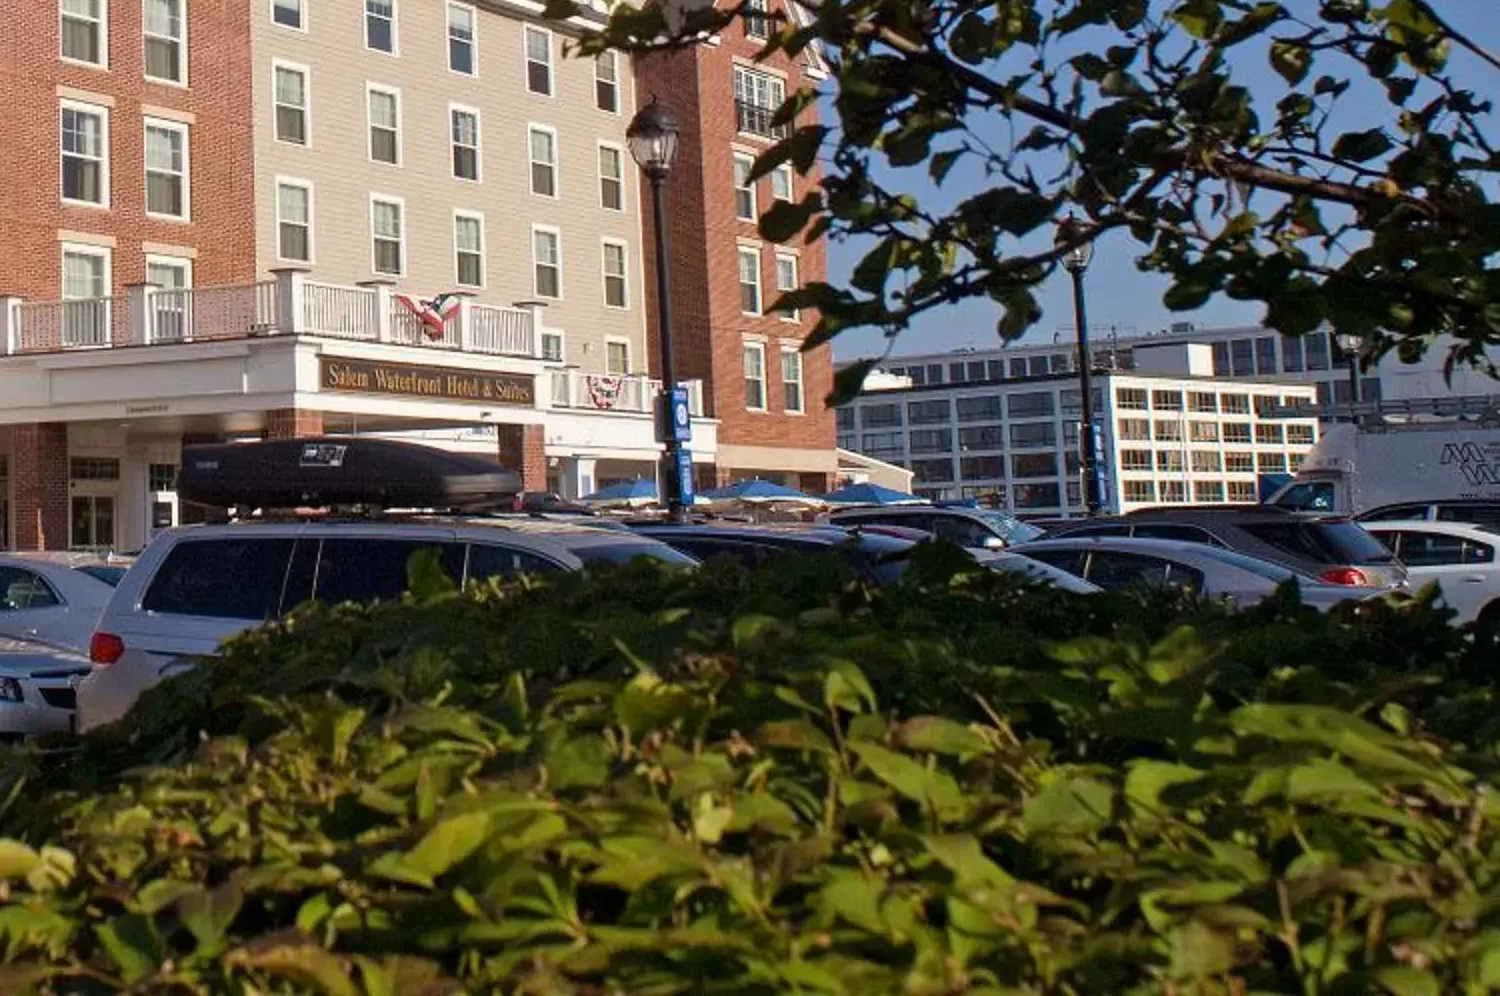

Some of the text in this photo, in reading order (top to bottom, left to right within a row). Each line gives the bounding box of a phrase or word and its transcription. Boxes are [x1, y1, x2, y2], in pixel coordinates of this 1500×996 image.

[329, 364, 529, 401] Salem Waterfront Hotel & Suites
